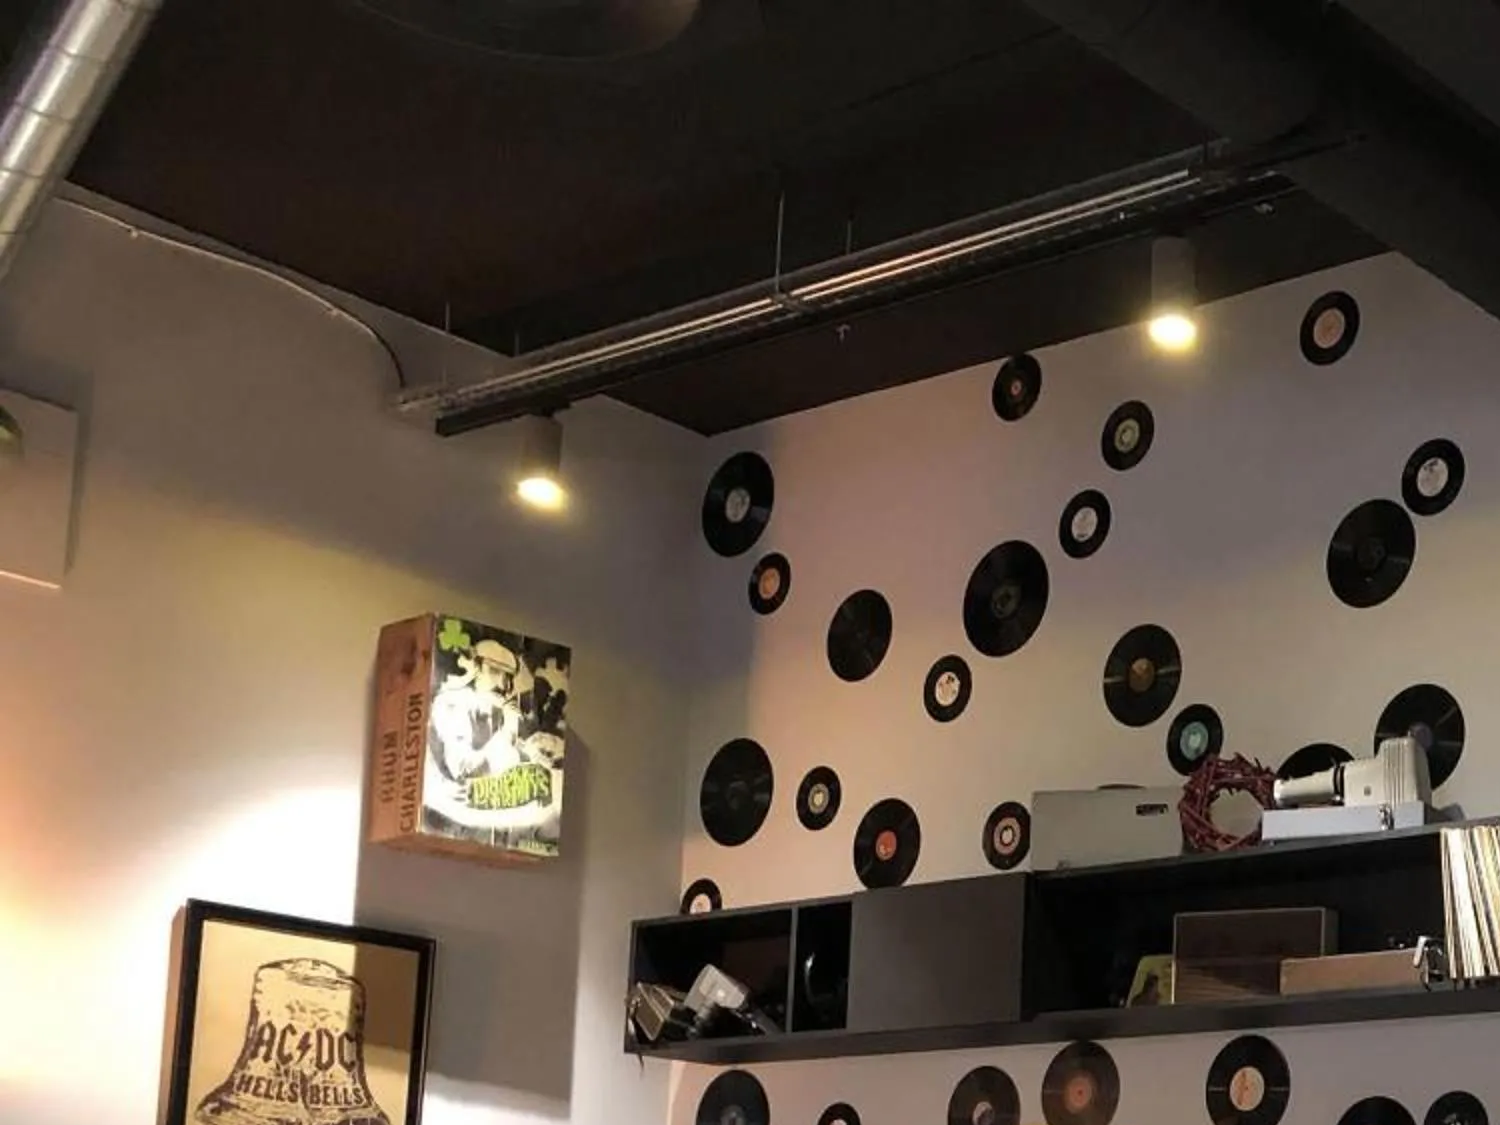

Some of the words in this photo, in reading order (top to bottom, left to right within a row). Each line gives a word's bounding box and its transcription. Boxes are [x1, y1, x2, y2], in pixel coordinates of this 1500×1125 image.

[380, 730, 398, 804] RHUM
[398, 692, 423, 833] CHARLESTON
[235, 1074, 300, 1103] HELLS
[307, 1081, 366, 1108] BELLS
